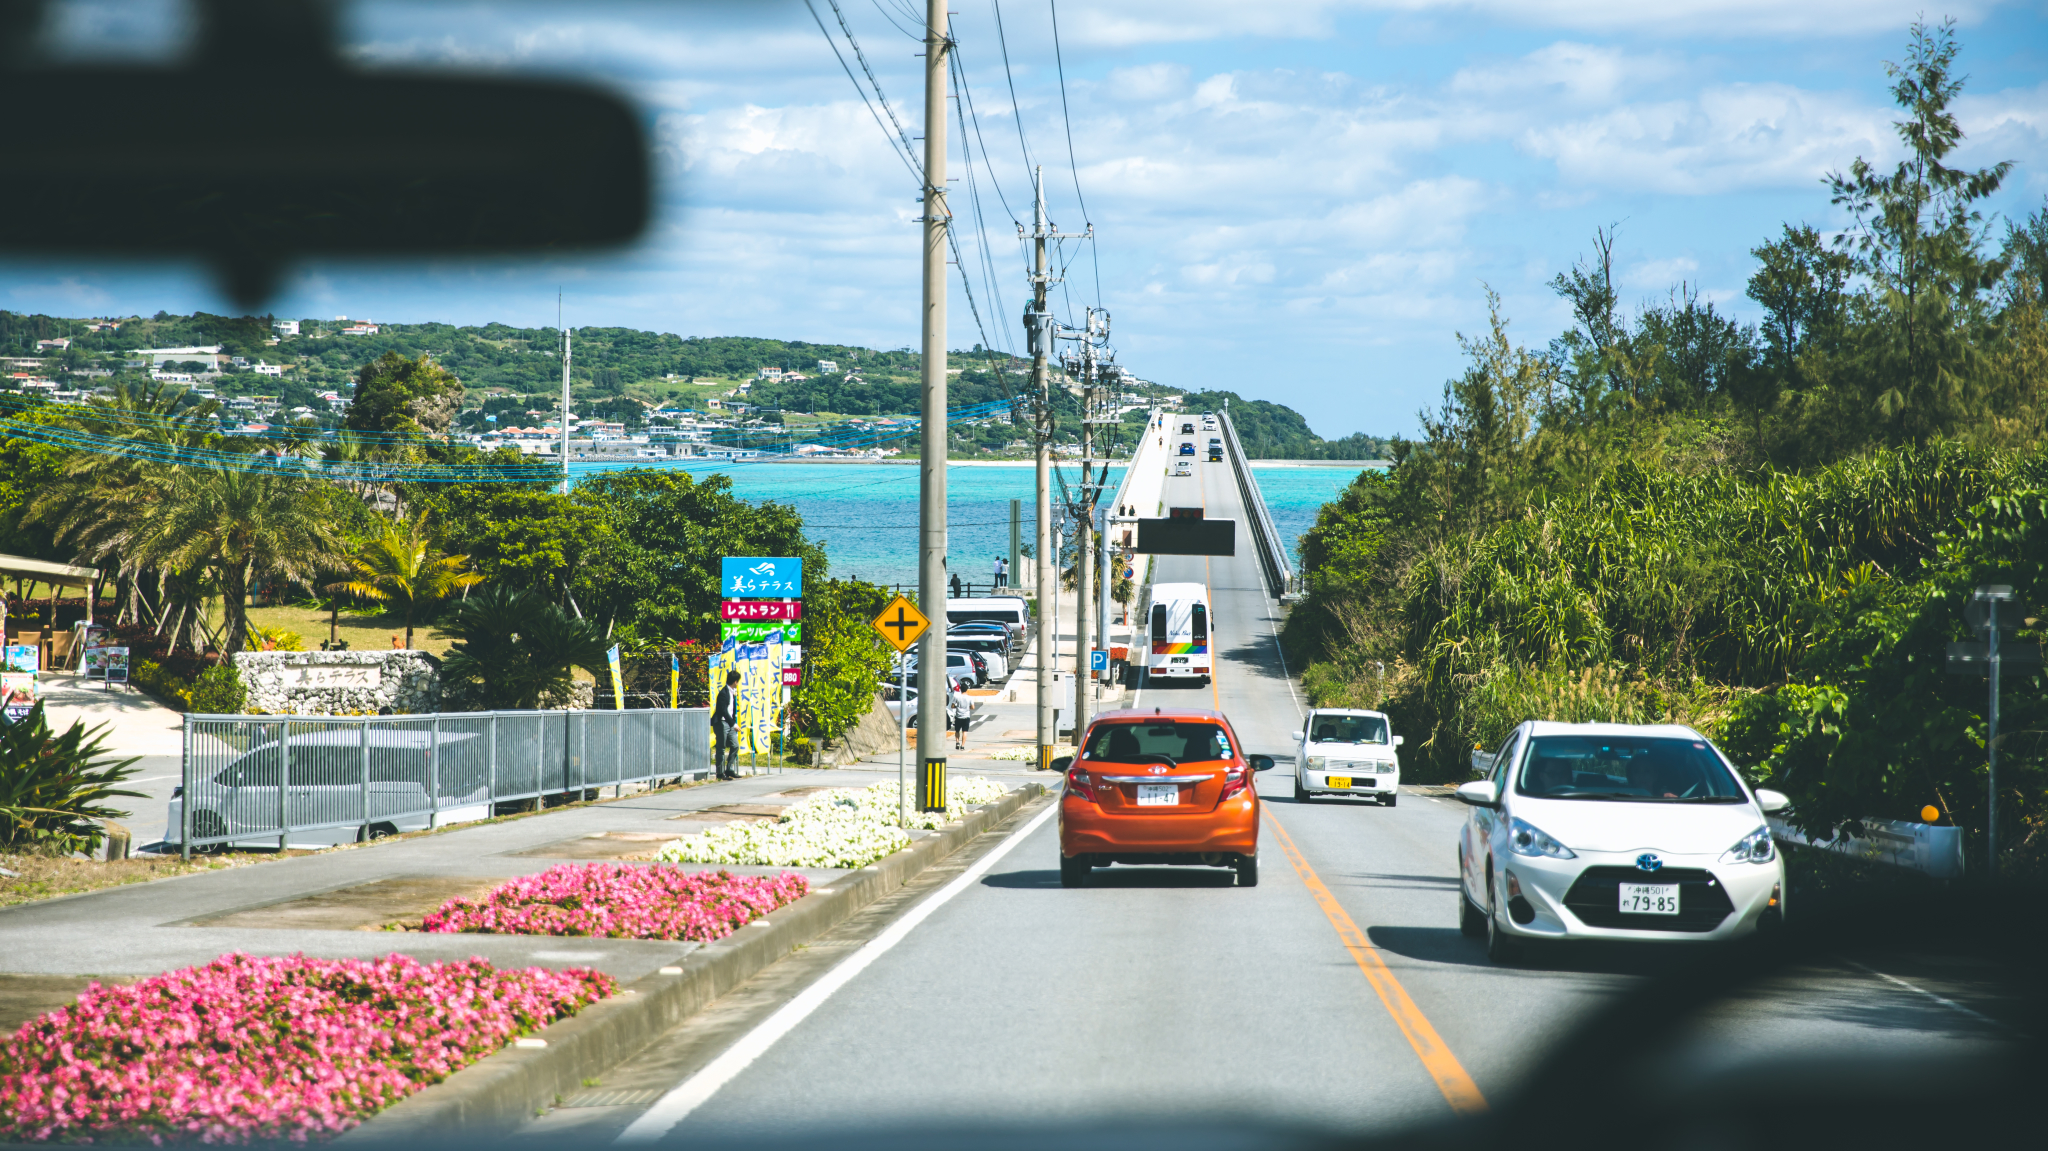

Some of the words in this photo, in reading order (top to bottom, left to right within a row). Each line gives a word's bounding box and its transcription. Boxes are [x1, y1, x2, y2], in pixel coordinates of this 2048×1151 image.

[729, 575, 793, 593] 美らテラス
[727, 604, 780, 616] レストラン
[1093, 653, 1103, 668] P
[783, 673, 797, 682] BBQ
[1148, 793, 1175, 804] 11-47
[1632, 895, 1675, 912] 79-85
